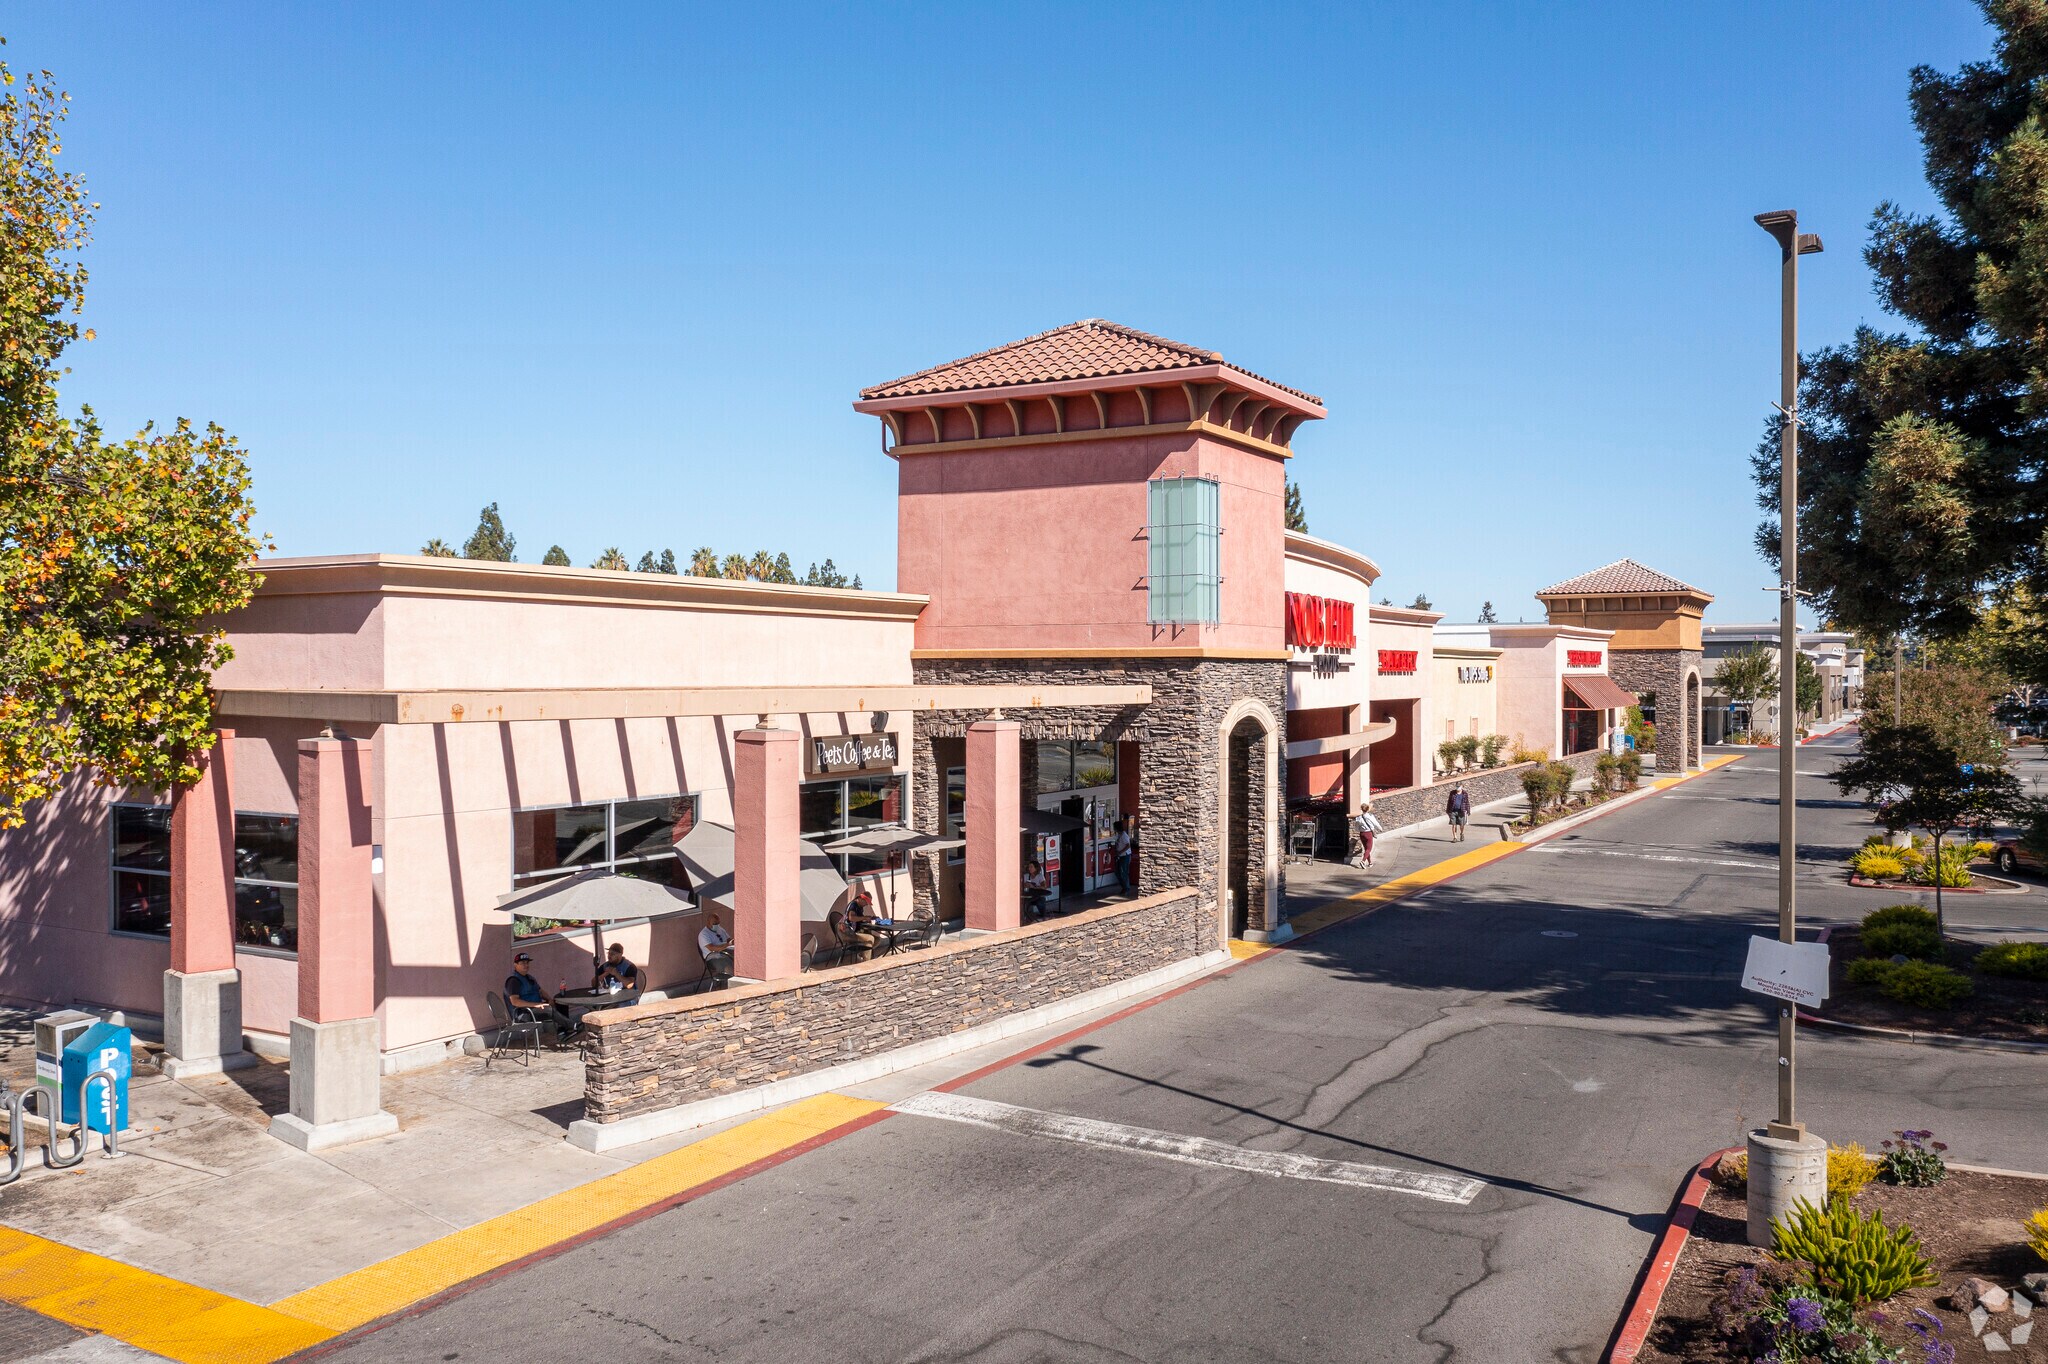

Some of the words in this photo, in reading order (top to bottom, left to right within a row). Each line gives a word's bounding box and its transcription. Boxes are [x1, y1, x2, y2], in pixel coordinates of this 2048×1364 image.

[1324, 598, 1356, 649] HILL
[1378, 650, 1418, 671] BAKERY
[843, 741, 872, 766] Coffee
[872, 745, 881, 759] &
[879, 738, 896, 761] Tea
[1757, 981, 1781, 992] Mountain
[1782, 988, 1796, 996] View
